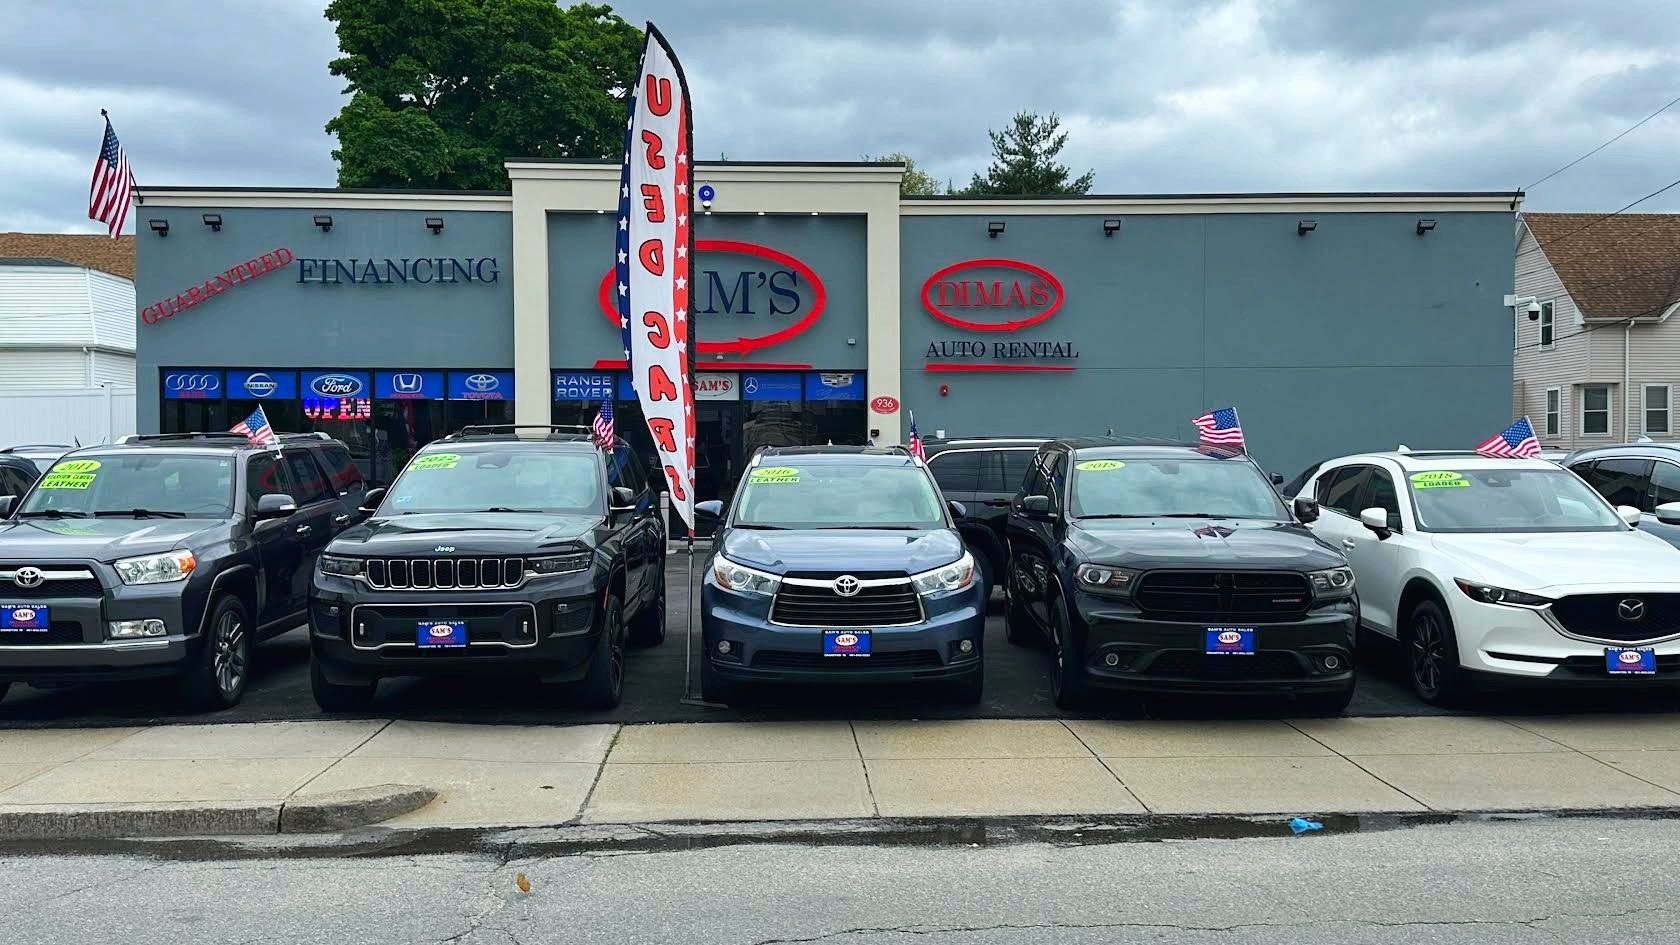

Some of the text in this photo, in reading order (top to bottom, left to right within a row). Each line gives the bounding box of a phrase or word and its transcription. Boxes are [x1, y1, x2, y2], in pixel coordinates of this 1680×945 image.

[296, 257, 500, 285] FINANCING
[141, 247, 294, 326] GUARANTEED
[695, 270, 800, 316] M'S
[937, 279, 1050, 307] DIMAS
[926, 341, 1079, 359] AUTO RENTAL
[321, 377, 353, 393] Ford
[556, 375, 612, 386] RANGE
[556, 387, 613, 398] ROVER
[303, 397, 371, 420] OPEN
[876, 398, 894, 408] 936
[59, 462, 95, 471] 2011
[40, 480, 88, 488] LEATHER
[434, 545, 456, 553] Jeep
[837, 636, 857, 644] SAM'S
